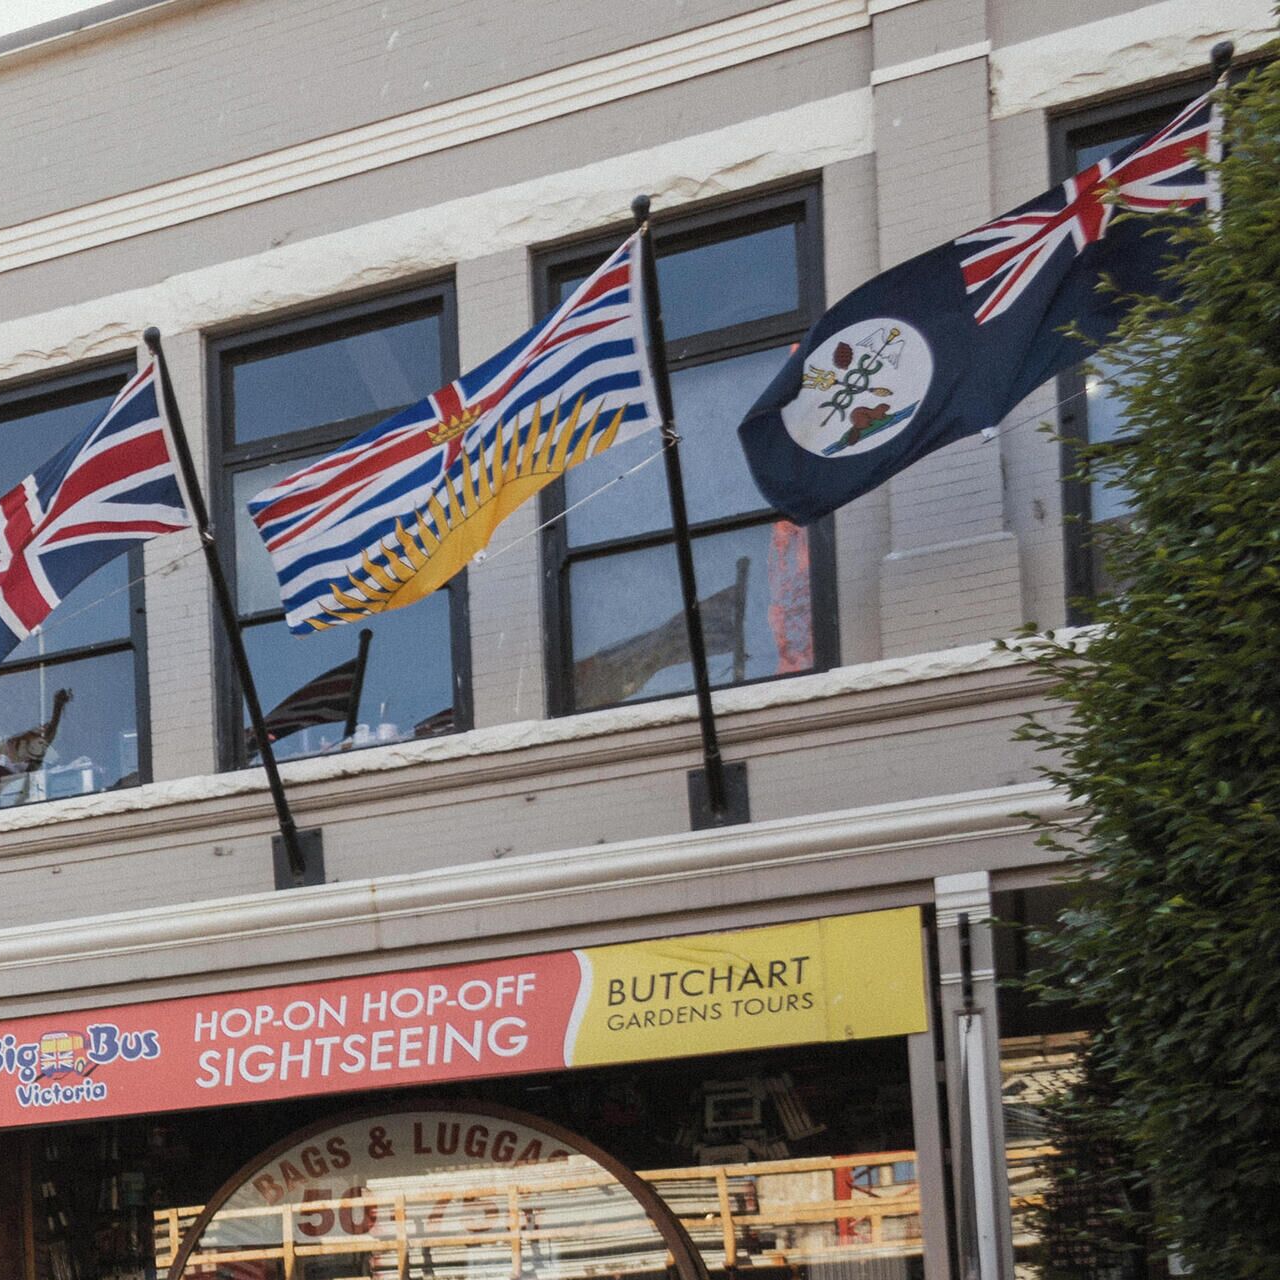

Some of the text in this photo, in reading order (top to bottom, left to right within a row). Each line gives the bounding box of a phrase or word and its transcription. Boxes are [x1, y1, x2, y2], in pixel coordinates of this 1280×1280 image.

[608, 956, 810, 1006] BUTCHART
[194, 973, 536, 1042] HOP-ON HOP-OFF
[607, 992, 814, 1031] GARDENS TOURS
[87, 1023, 160, 1064] Bus
[195, 1016, 529, 1088] SIGHTSEEING
[16, 1078, 107, 1108] Victoria
[252, 1121, 569, 1206] BAGS & LUGGA
